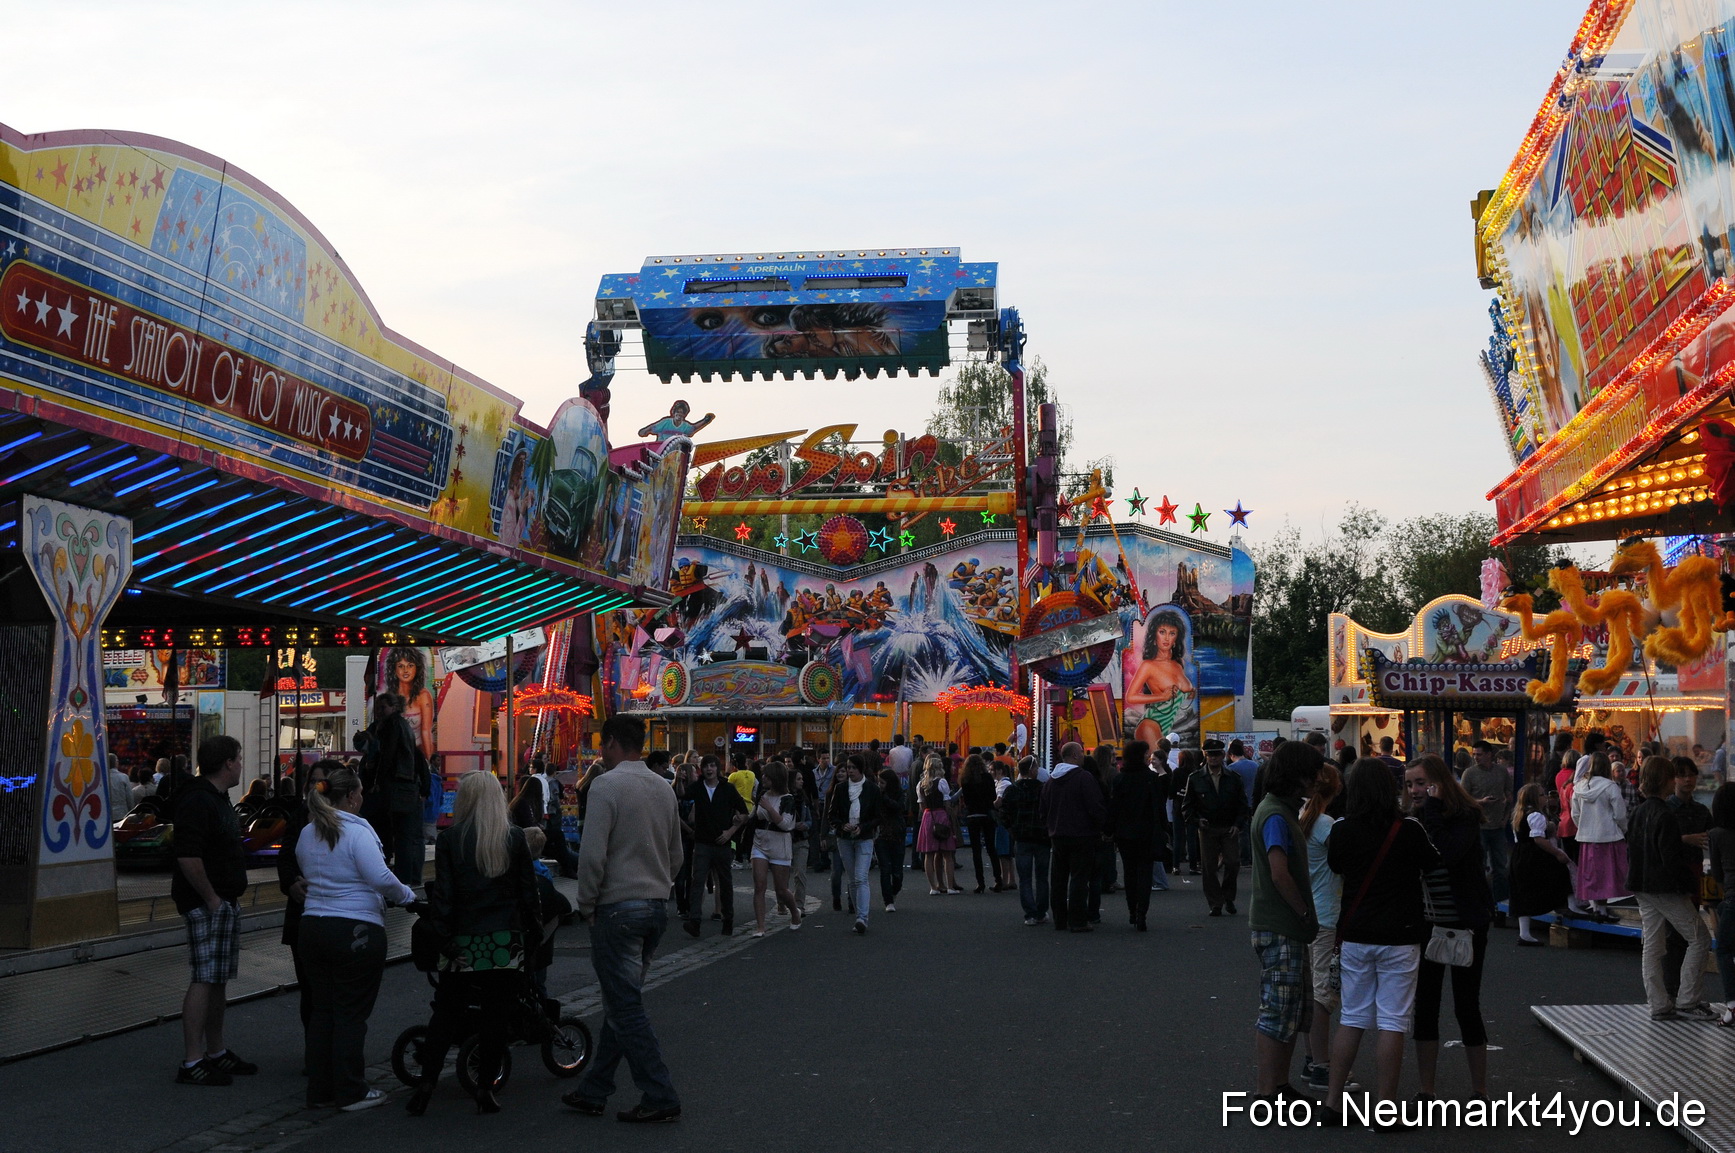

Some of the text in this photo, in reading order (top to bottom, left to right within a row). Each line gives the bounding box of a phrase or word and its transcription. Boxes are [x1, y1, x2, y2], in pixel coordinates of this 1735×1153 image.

[747, 263, 806, 275] ADRENALIN
[82, 296, 331, 442] THE STATION OF HOT MUSIC
[778, 423, 938, 498] Spin
[1384, 672, 1528, 696] Chip-Kasse
[951, 692, 1013, 707] SPLASH
[736, 725, 757, 733] Kasse
